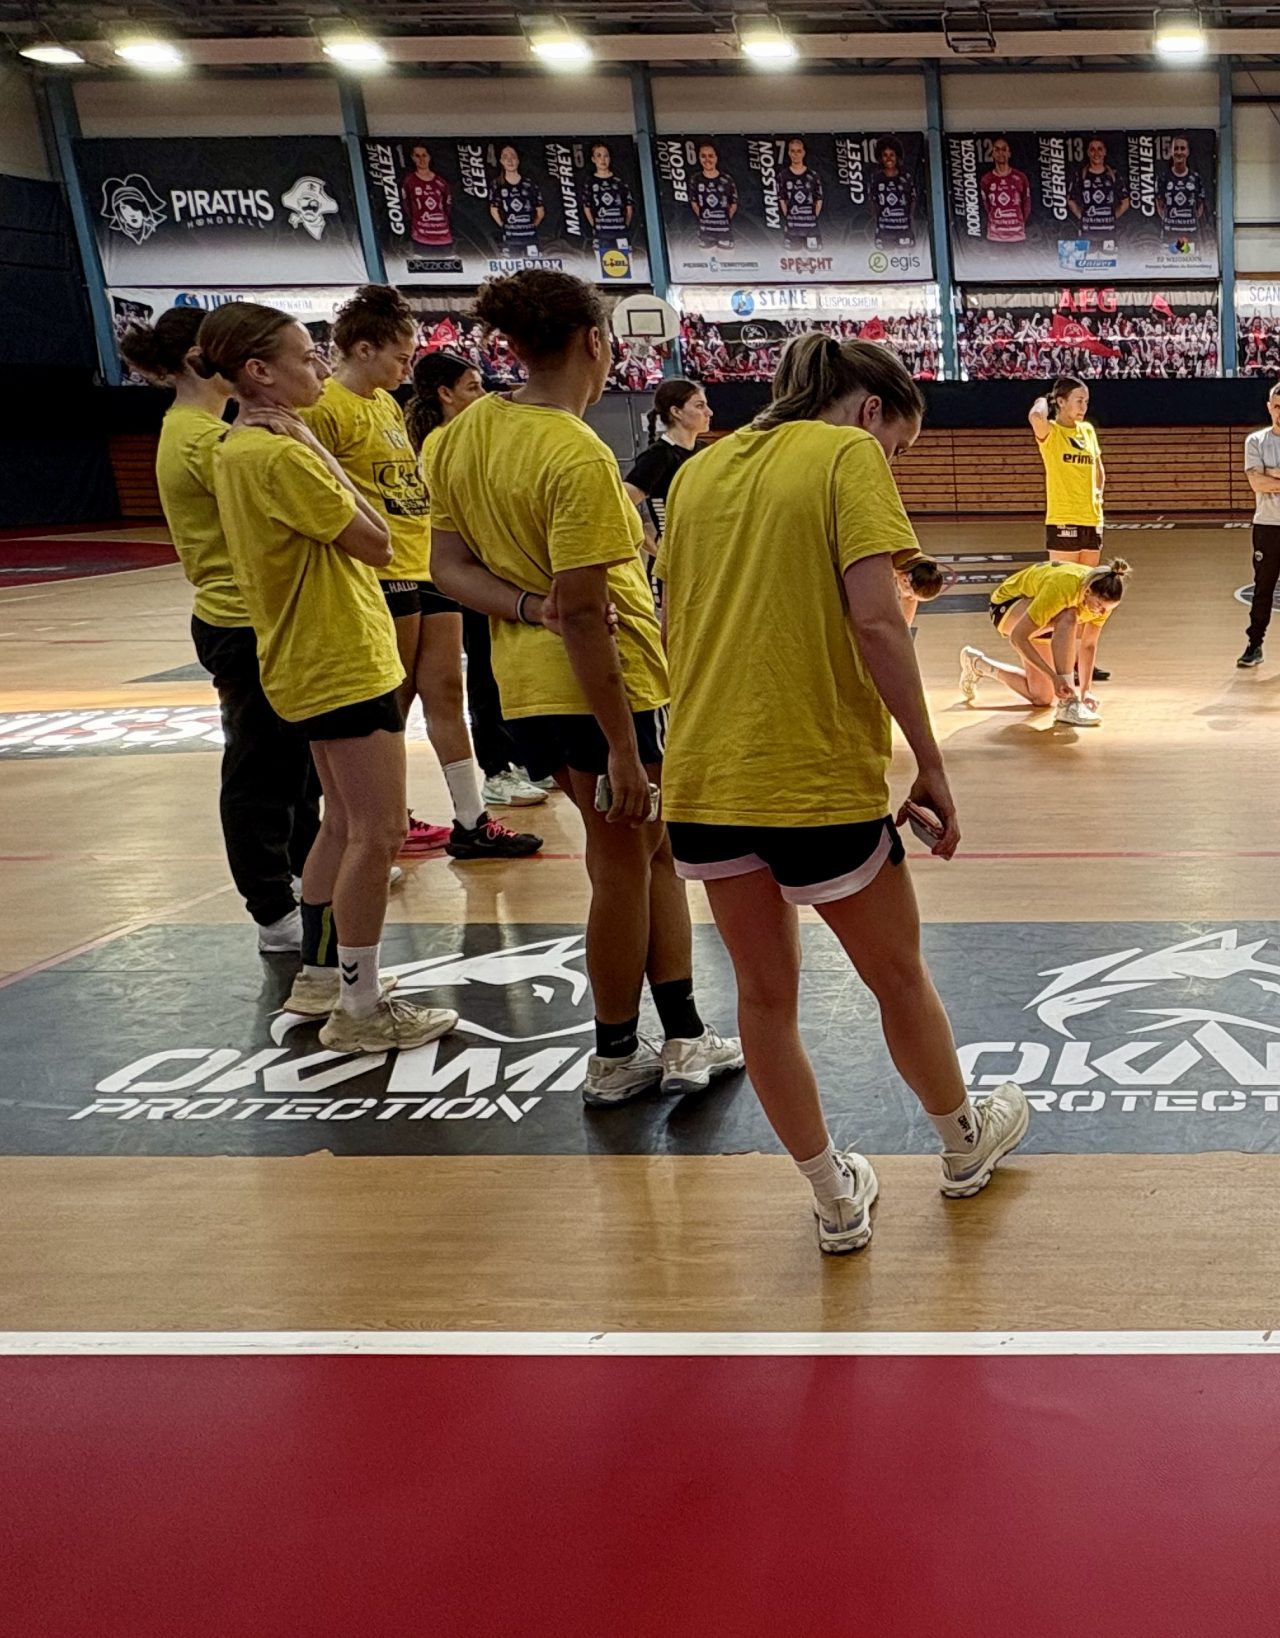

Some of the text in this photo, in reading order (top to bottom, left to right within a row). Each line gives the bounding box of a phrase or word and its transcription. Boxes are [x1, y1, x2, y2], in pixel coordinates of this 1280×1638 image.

[457, 144, 475, 196] AGATHE
[467, 144, 488, 199] CLERC
[545, 143, 561, 179] JULIA
[655, 141, 672, 179] LILOU
[667, 141, 689, 203] BEGON
[748, 140, 761, 170] ELIN
[834, 139, 850, 185] LOUISE
[846, 139, 865, 205] CUSSET
[949, 138, 965, 217] ELIHANNAH
[1050, 136, 1068, 221] GUERRIER
[1128, 135, 1141, 210] CORENTINE
[1139, 135, 1156, 217] CAVALIER
[170, 188, 275, 224] PIRATHS
[377, 144, 405, 235] GONZALEZ
[556, 144, 582, 236] MAUFFREY
[758, 140, 781, 229] KARLSSON
[890, 254, 921, 271] egis
[759, 289, 808, 307] STANE
[67, 1096, 543, 1123] PROTECTION
